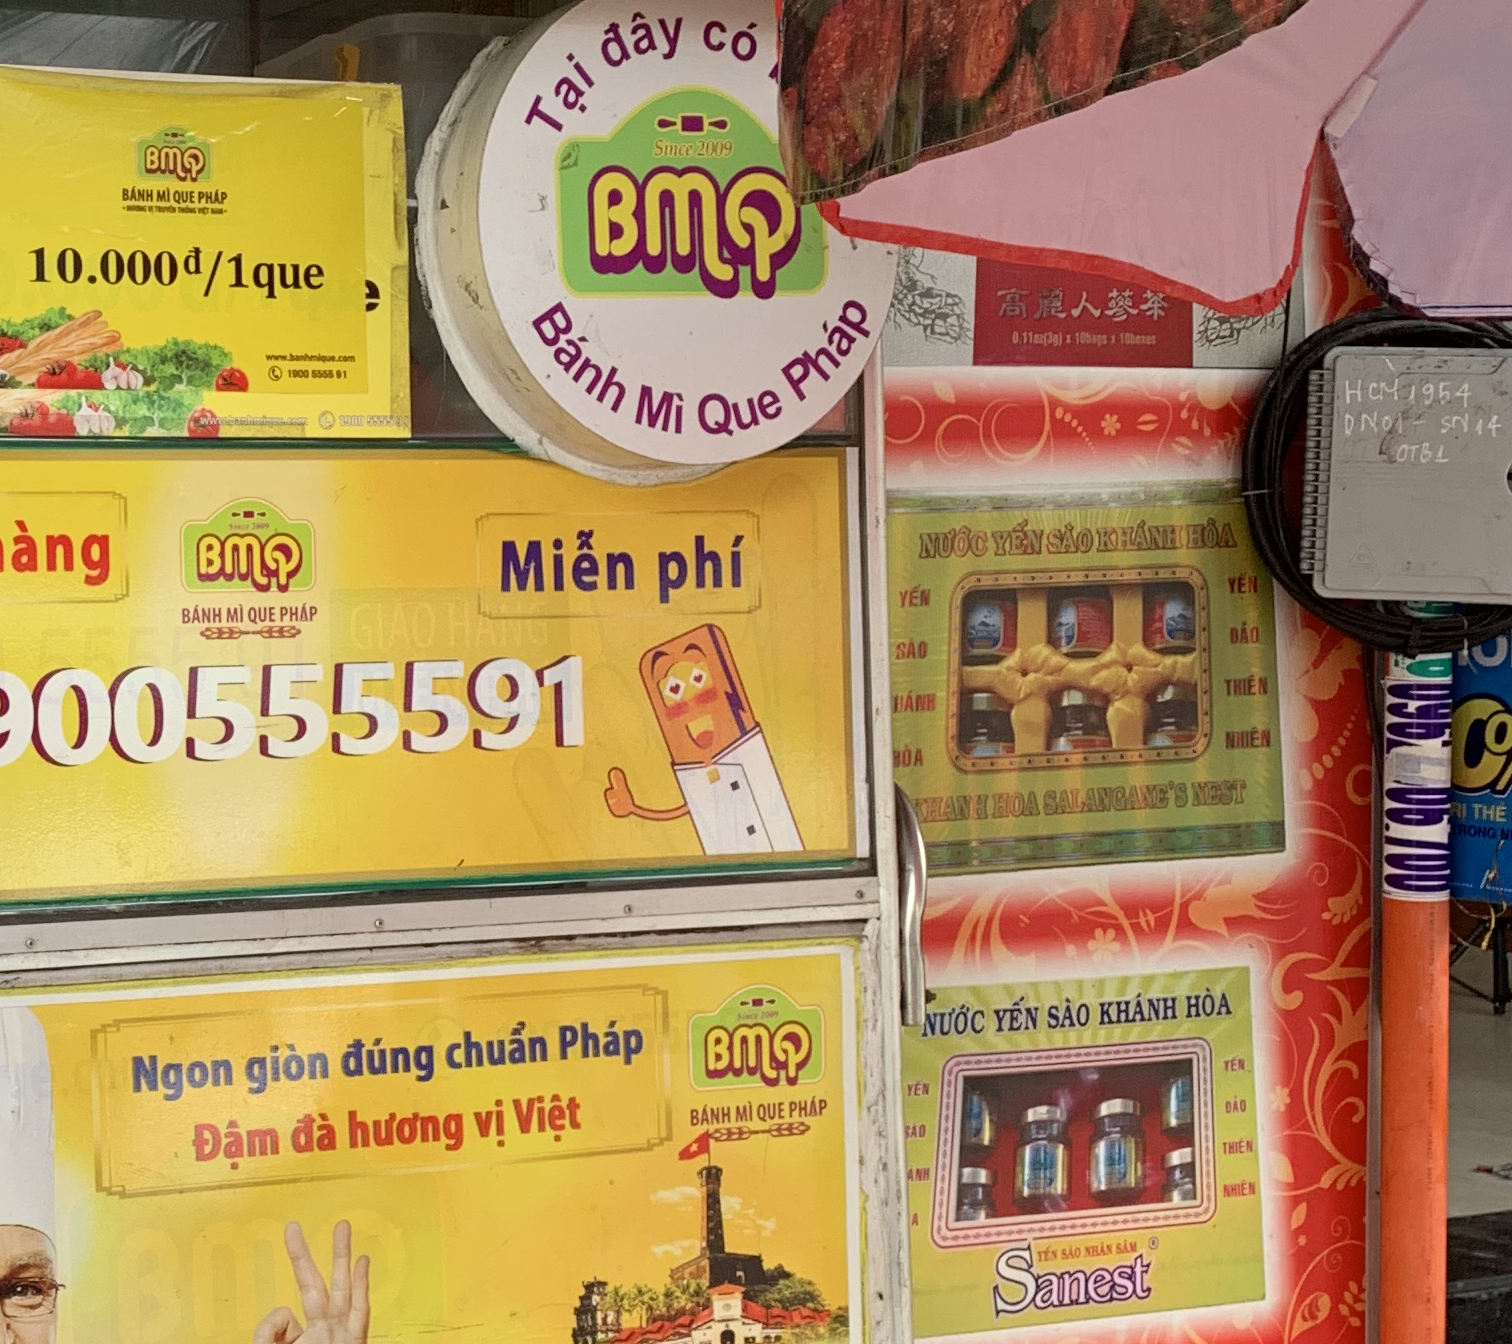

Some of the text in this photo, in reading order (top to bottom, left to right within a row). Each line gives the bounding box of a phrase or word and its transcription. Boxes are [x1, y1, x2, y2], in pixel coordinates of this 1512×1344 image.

[524, 11, 758, 134] Tại đây có
[145, 145, 206, 183] BMQ
[654, 138, 732, 158] Since 2009
[122, 186, 228, 205] BÁNH MÌ QUE PHÁP
[590, 164, 802, 300] BMQ
[28, 246, 325, 299] 10.000đ/1que
[531, 299, 868, 437] Bánh Mì Que Pháp
[197, 533, 303, 593] BMQ
[993, 519, 1043, 556] YẾN
[1097, 520, 1183, 554] KHÁNH
[1188, 517, 1236, 549] HÒA
[501, 529, 744, 602] Miễn phí
[182, 603, 317, 624] BÁNH MÌ QUE PHÁP
[992, 793, 1041, 820] HOA
[1192, 779, 1246, 806] NEST
[921, 987, 1233, 1038] NƯỚC YẾN SÀO KHÁNH HÒA
[131, 1050, 235, 1104] Ngon
[244, 1041, 329, 1101] giòn
[341, 1033, 436, 1094] đúng
[446, 1024, 552, 1073] chuẩn
[559, 1022, 644, 1077] Pháp
[703, 1020, 812, 1086] BMQ
[192, 1093, 583, 1173] Đậm đà hương vị Việt
[689, 1096, 827, 1126] BÁNH MÌ QUE PHÁP
[994, 1244, 1152, 1318] Sanest
